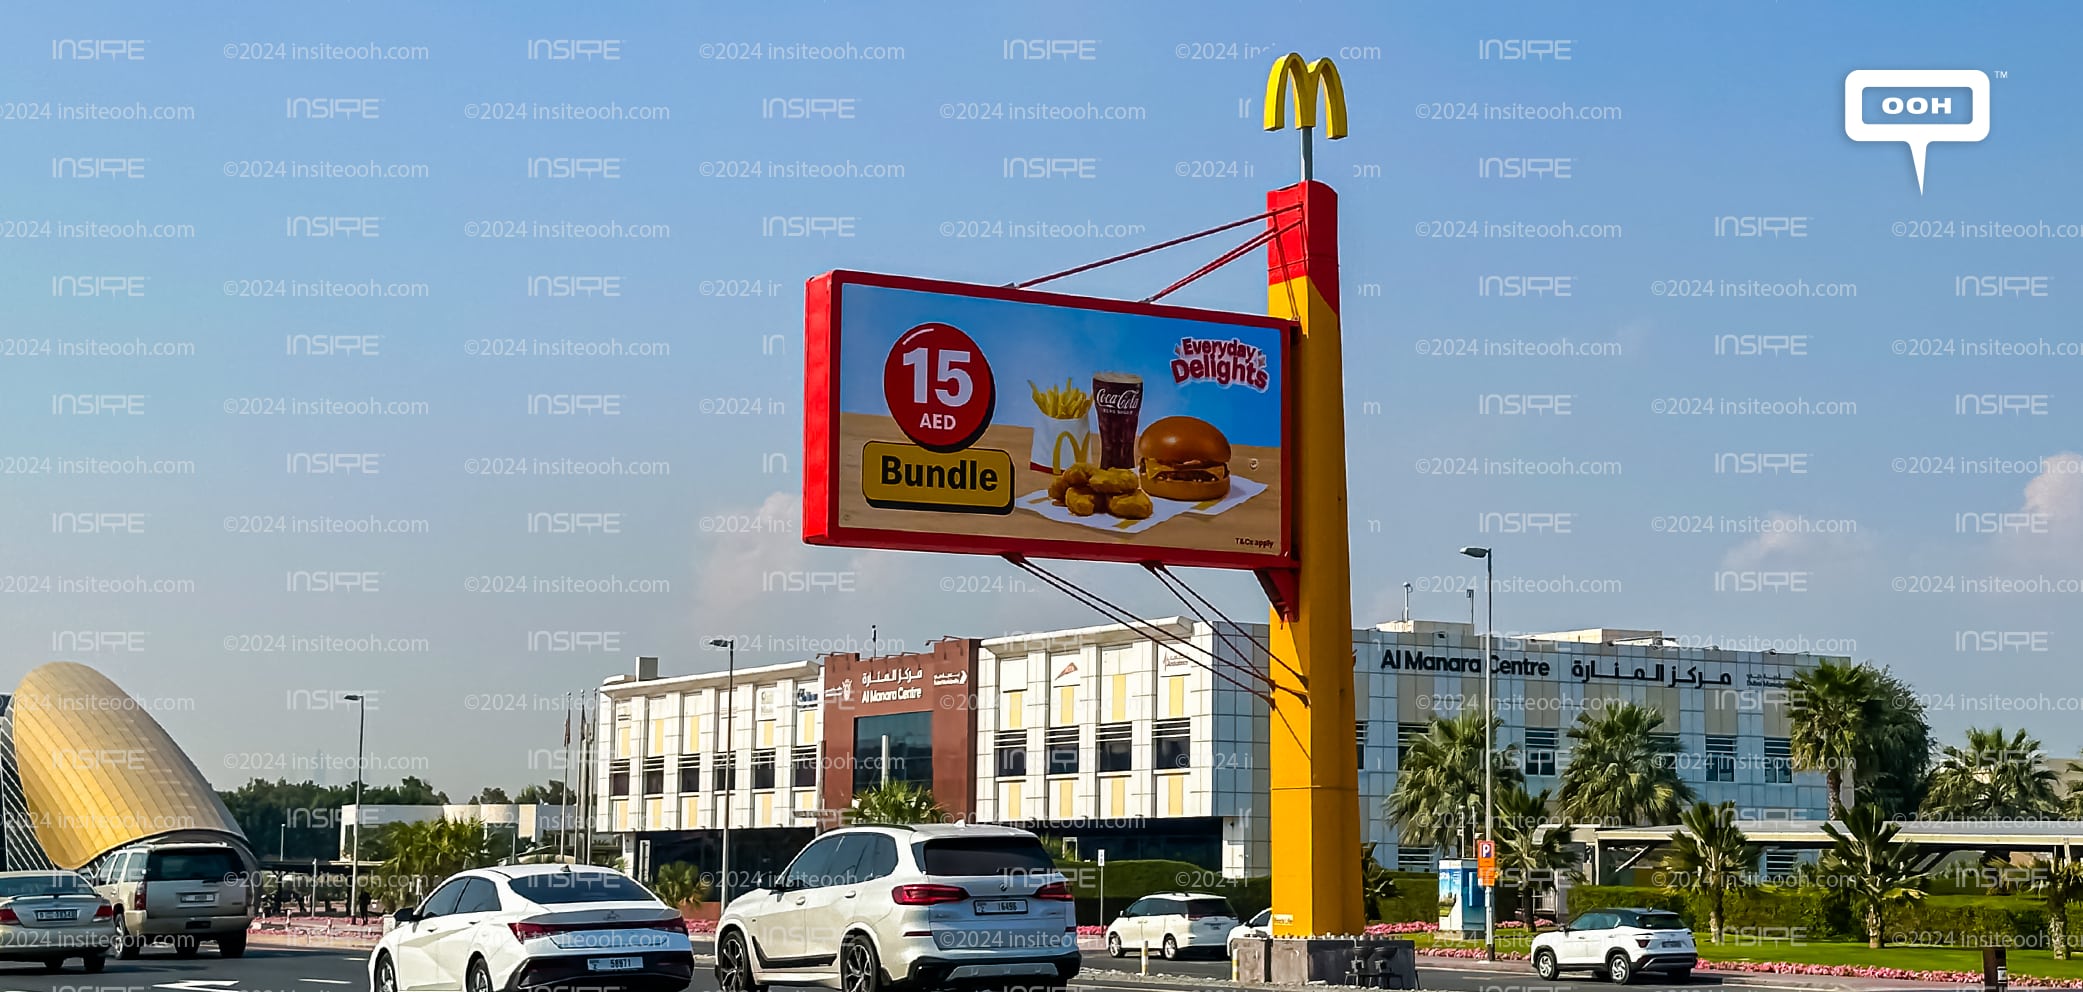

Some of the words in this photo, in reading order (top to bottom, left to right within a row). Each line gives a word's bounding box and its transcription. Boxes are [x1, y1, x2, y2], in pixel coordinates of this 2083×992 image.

[1181, 338, 1257, 363] Everyday
[903, 347, 974, 407] 15
[1171, 355, 1268, 389] Delights
[919, 413, 957, 431] AED
[881, 456, 998, 492] Bundle
[1254, 539, 1275, 549] apply
[1381, 649, 1401, 669] Al
[1404, 651, 1482, 673] Manara
[1489, 655, 1550, 677] Centre
[1571, 660, 1664, 684] المنارة
[862, 668, 896, 688] المنارة
[898, 667, 923, 684] مركز
[1668, 665, 1732, 689] مركز
[898, 687, 922, 700] Centre
